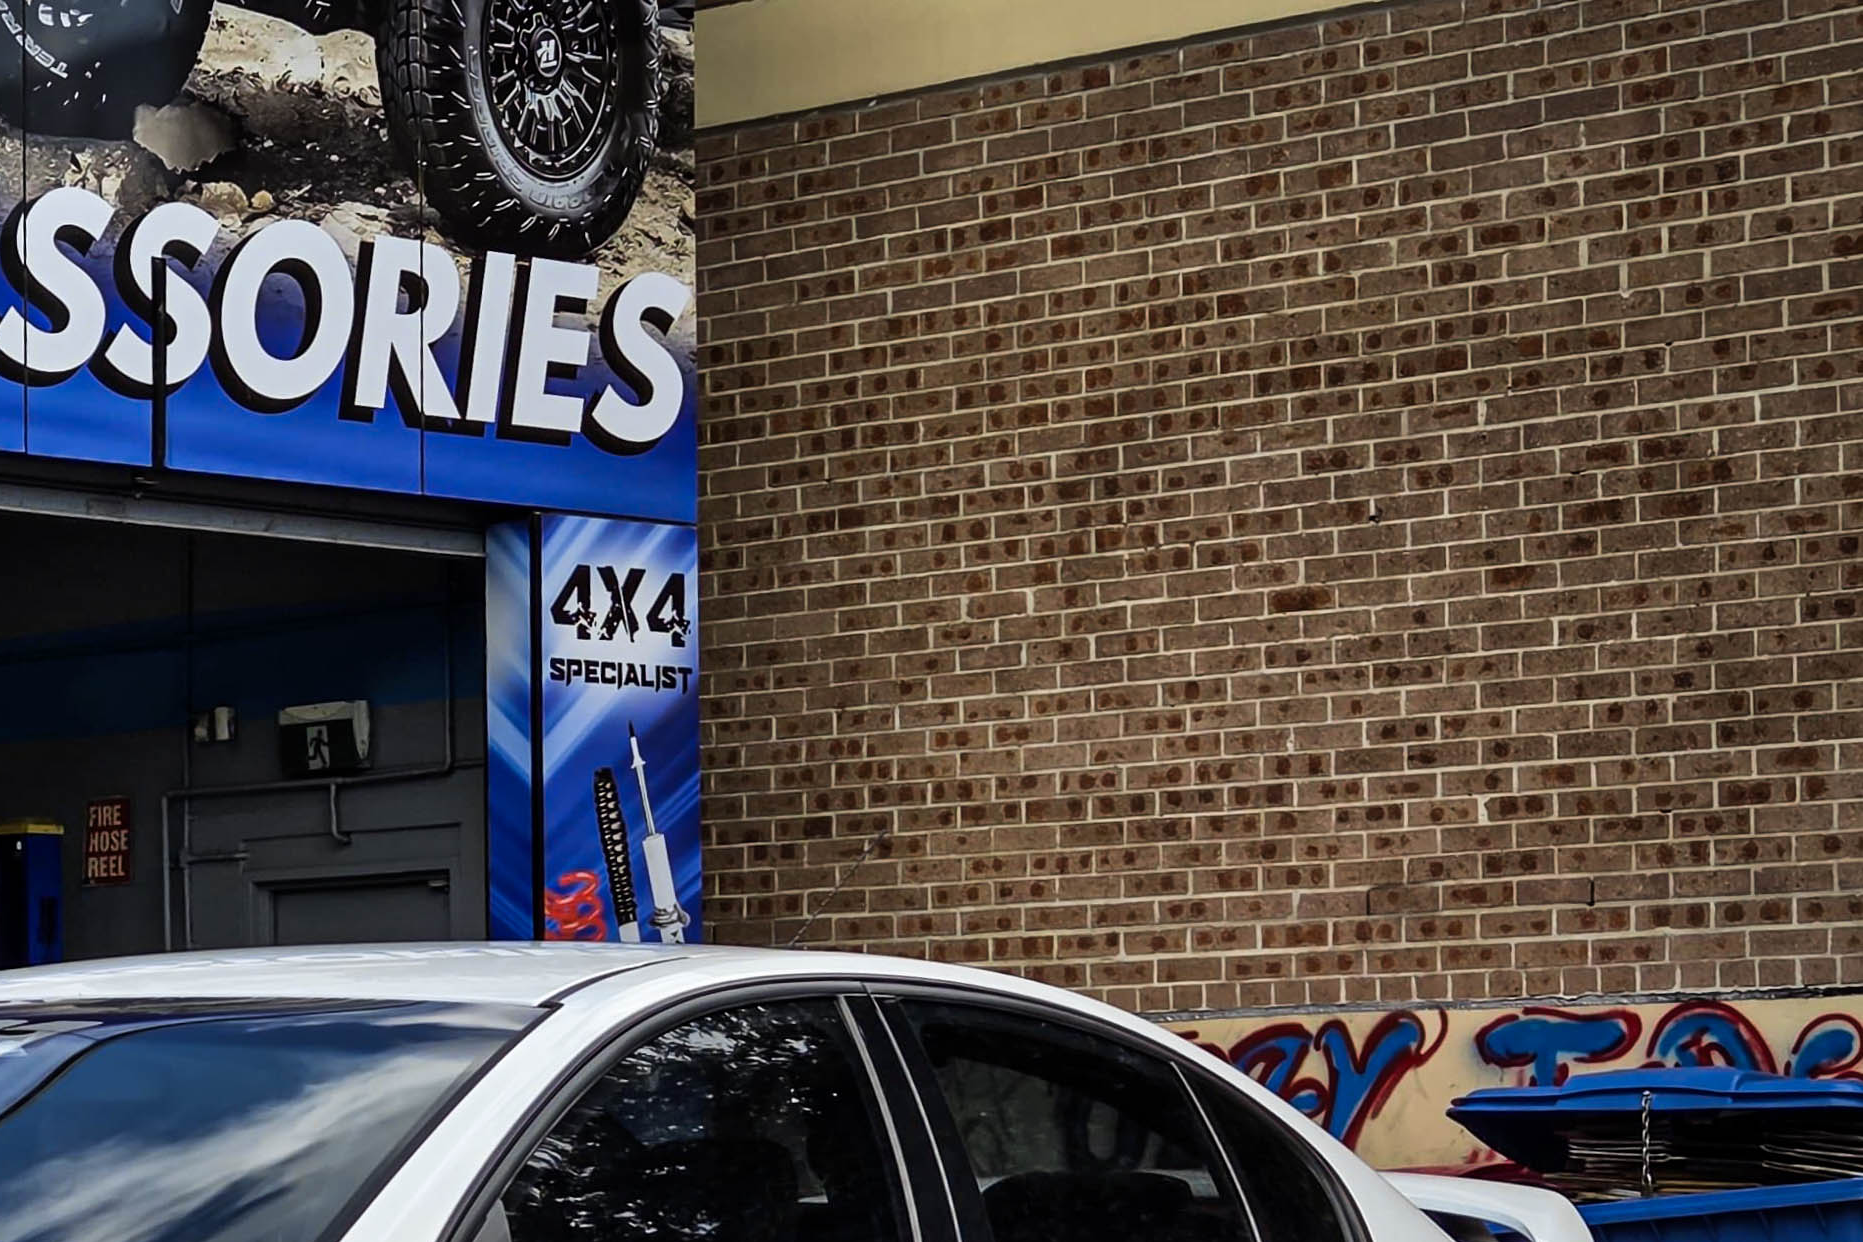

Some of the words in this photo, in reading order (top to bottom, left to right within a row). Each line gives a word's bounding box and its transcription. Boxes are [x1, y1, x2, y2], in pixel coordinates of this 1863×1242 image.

[550, 564, 691, 648] 4X4
[549, 657, 693, 695] SPECIALIST
[89, 805, 122, 827] FIRE
[89, 829, 129, 853] HOSE
[87, 855, 126, 878] REEL
